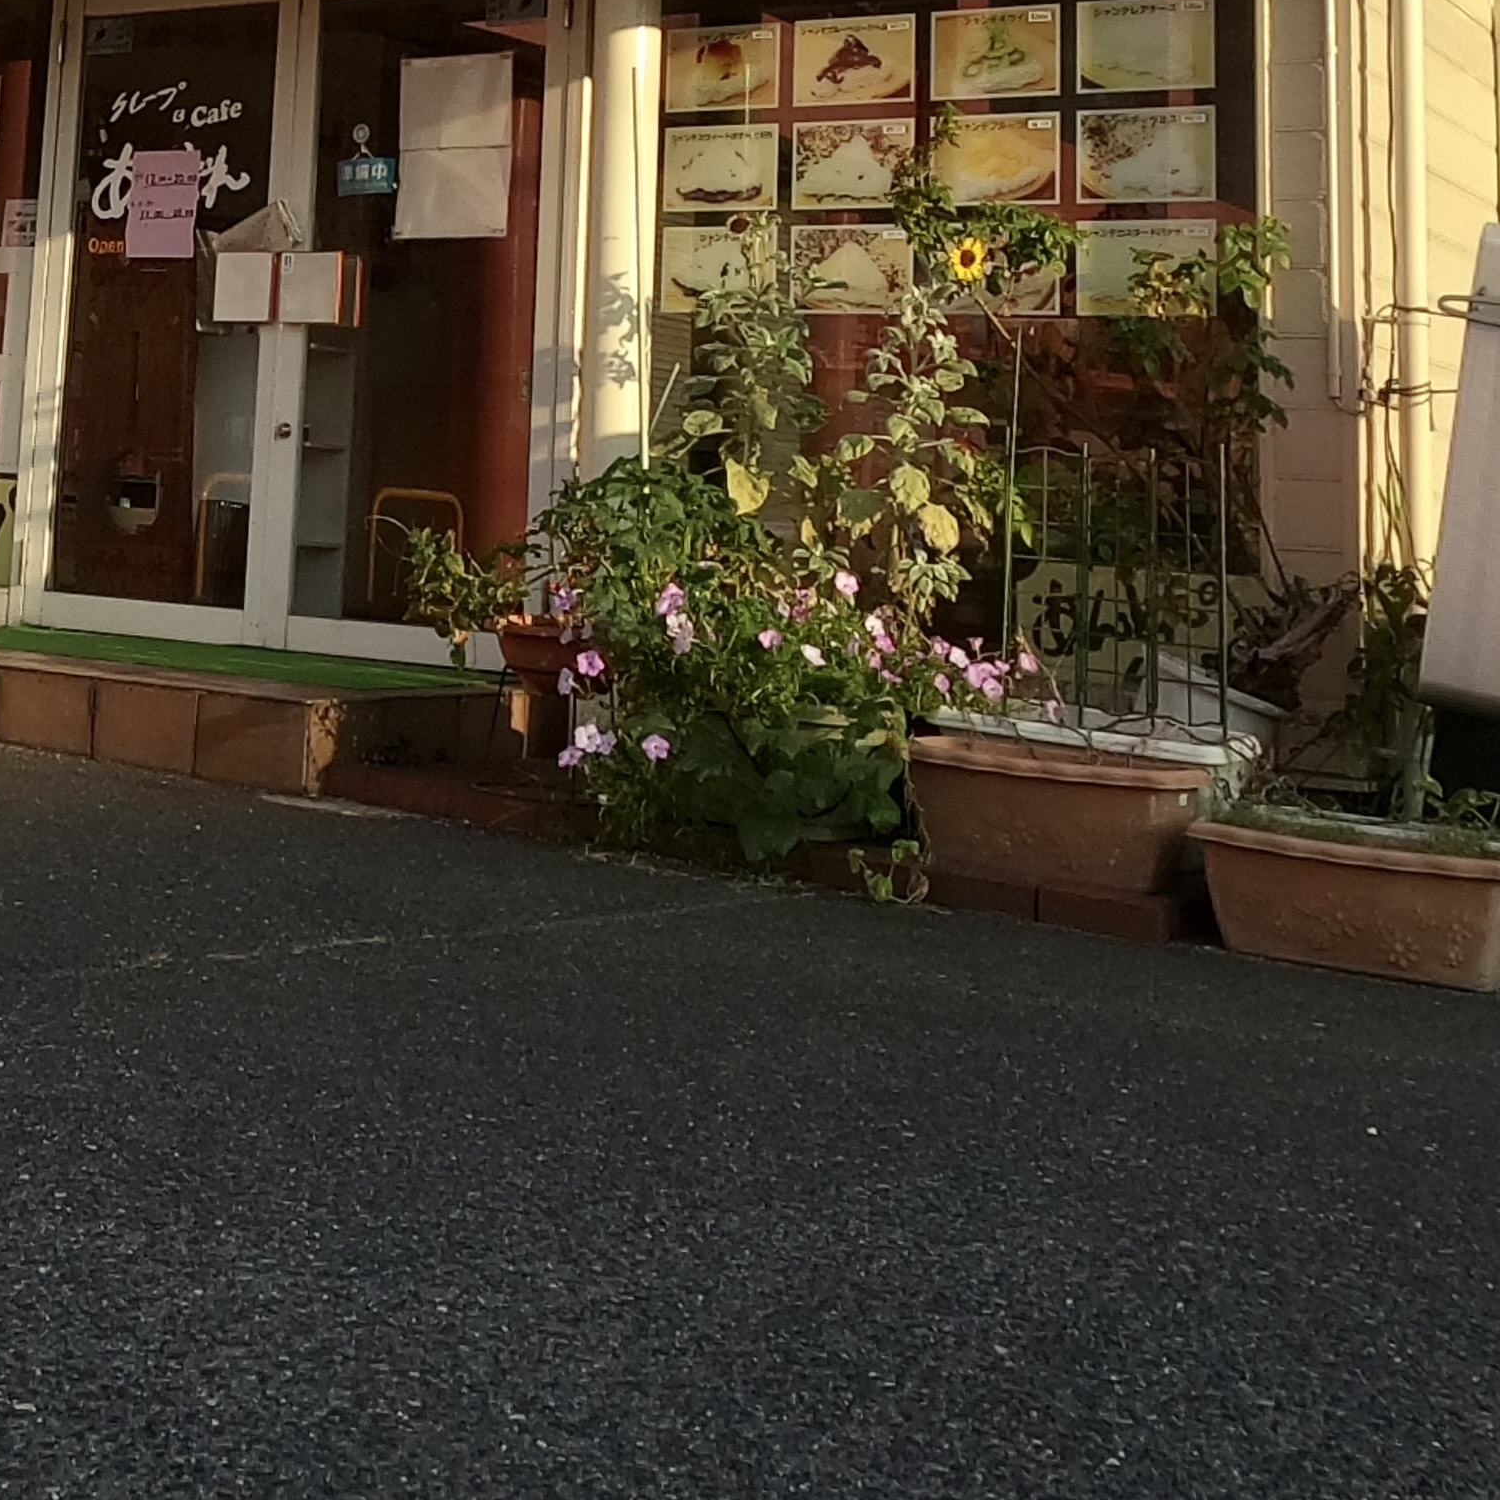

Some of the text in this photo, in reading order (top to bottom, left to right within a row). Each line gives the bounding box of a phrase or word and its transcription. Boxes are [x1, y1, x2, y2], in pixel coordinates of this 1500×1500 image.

[109, 81, 187, 122] クレープ
[190, 99, 243, 128] Cafe
[91, 141, 250, 219] あれ
[88, 237, 125, 255] Open
